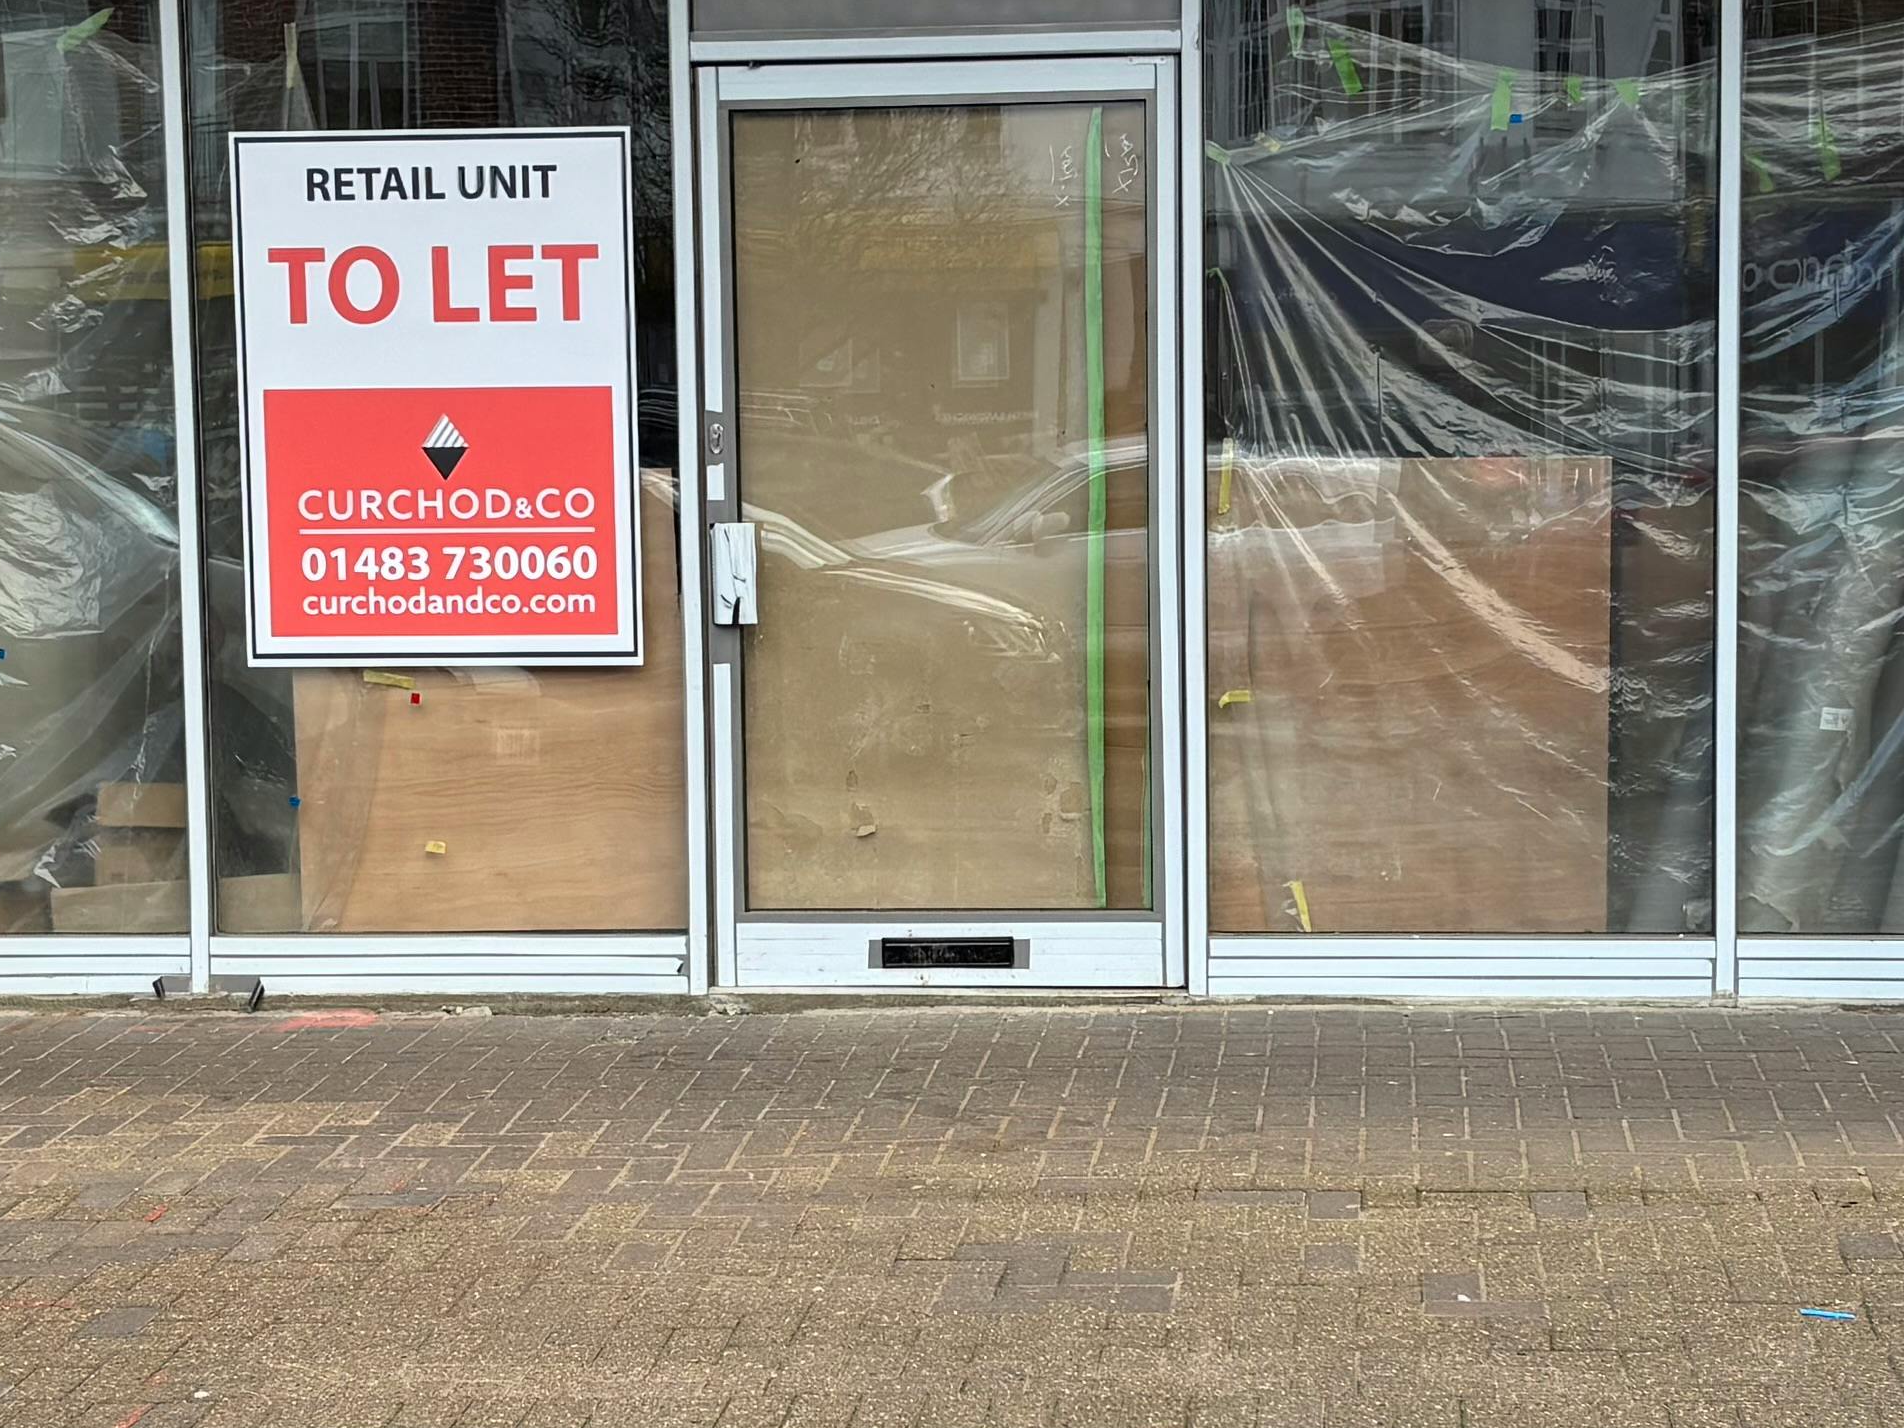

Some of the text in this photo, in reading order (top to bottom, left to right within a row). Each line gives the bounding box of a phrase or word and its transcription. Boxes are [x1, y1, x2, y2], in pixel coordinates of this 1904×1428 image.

[305, 164, 558, 202] RETAIL UNIT
[267, 243, 600, 325] TO LET
[298, 486, 596, 521] CURCHOD&CO
[300, 544, 598, 583] 01483 730060
[302, 587, 596, 616] curchodandco.com
